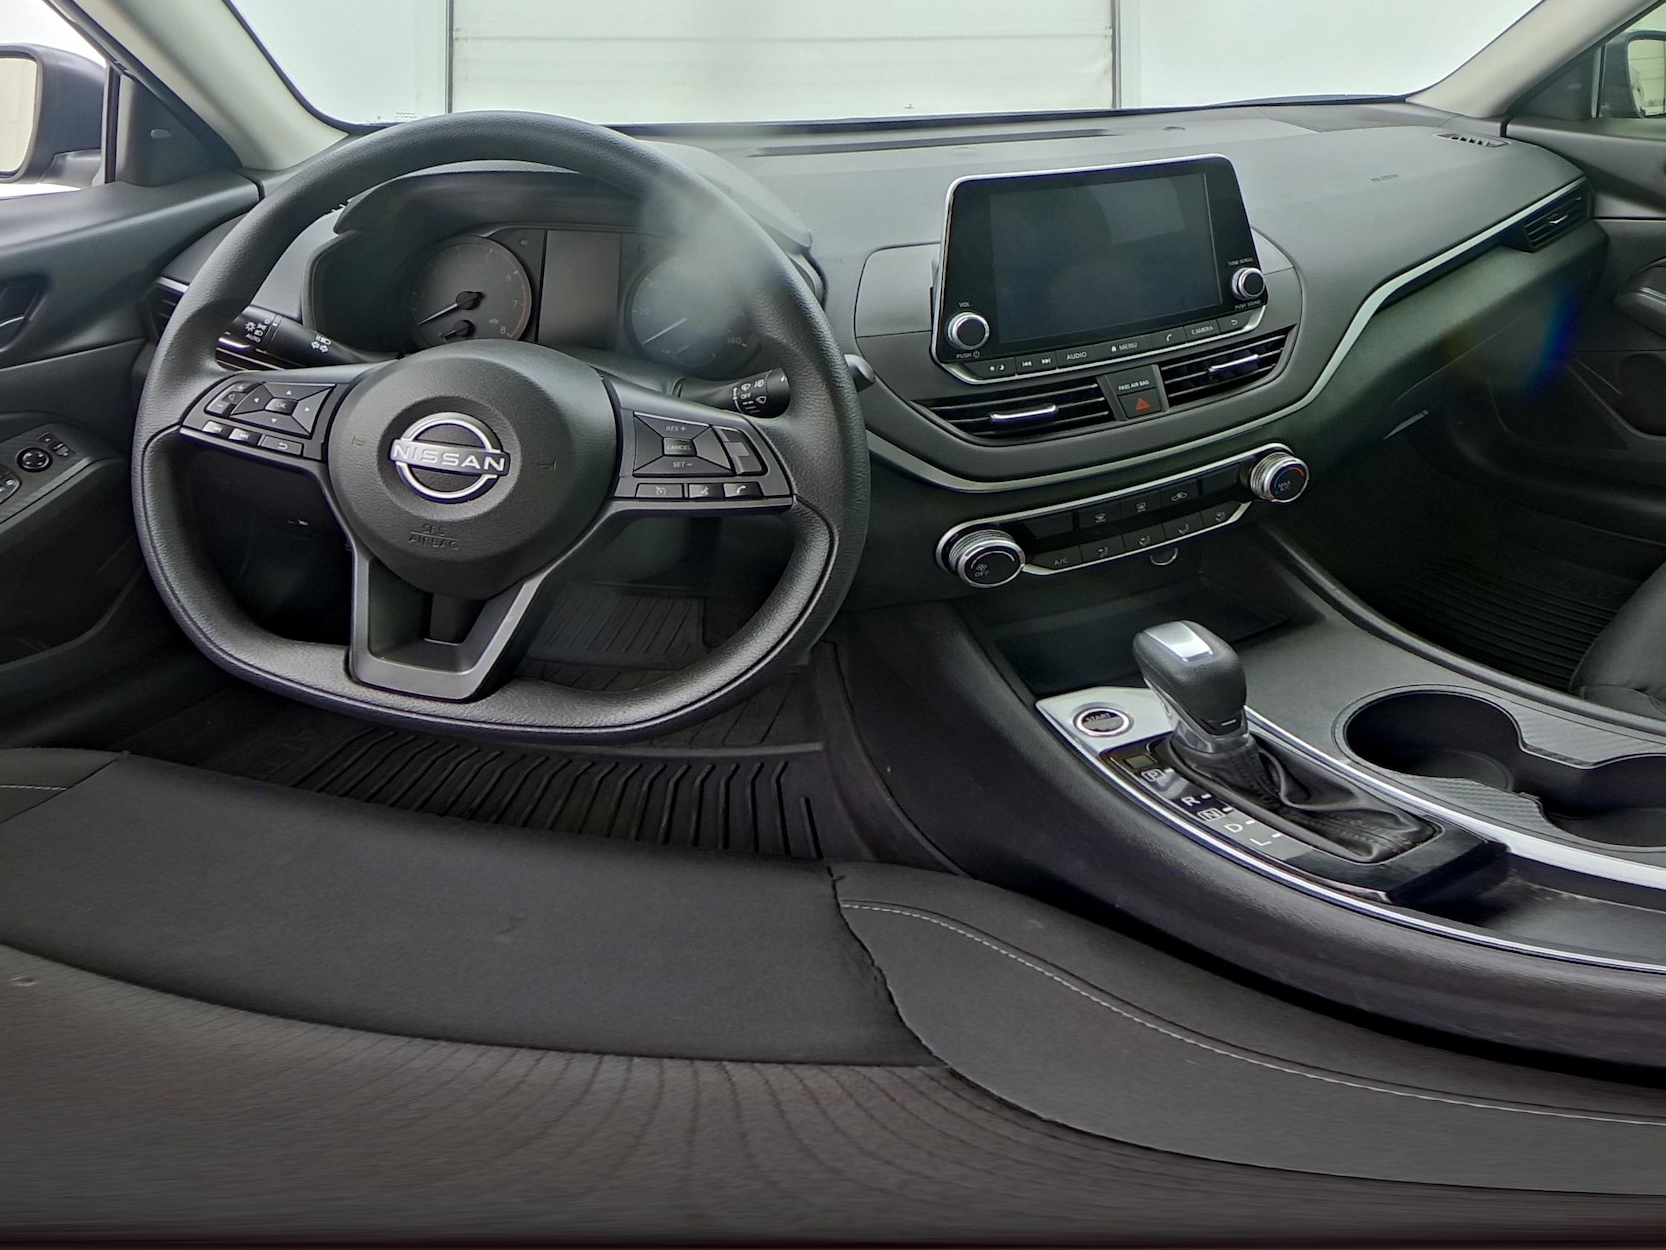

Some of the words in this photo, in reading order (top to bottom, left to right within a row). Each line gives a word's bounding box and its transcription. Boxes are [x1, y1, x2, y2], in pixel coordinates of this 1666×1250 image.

[500, 326, 506, 334] 8
[1192, 326, 1213, 335] CAMERA
[246, 334, 261, 343] AUTO
[1066, 352, 1087, 360] AUDIO
[393, 444, 505, 471] NISSAN
[1181, 797, 1200, 806] R
[1224, 823, 1243, 833] D
[1250, 837, 1272, 846] L
